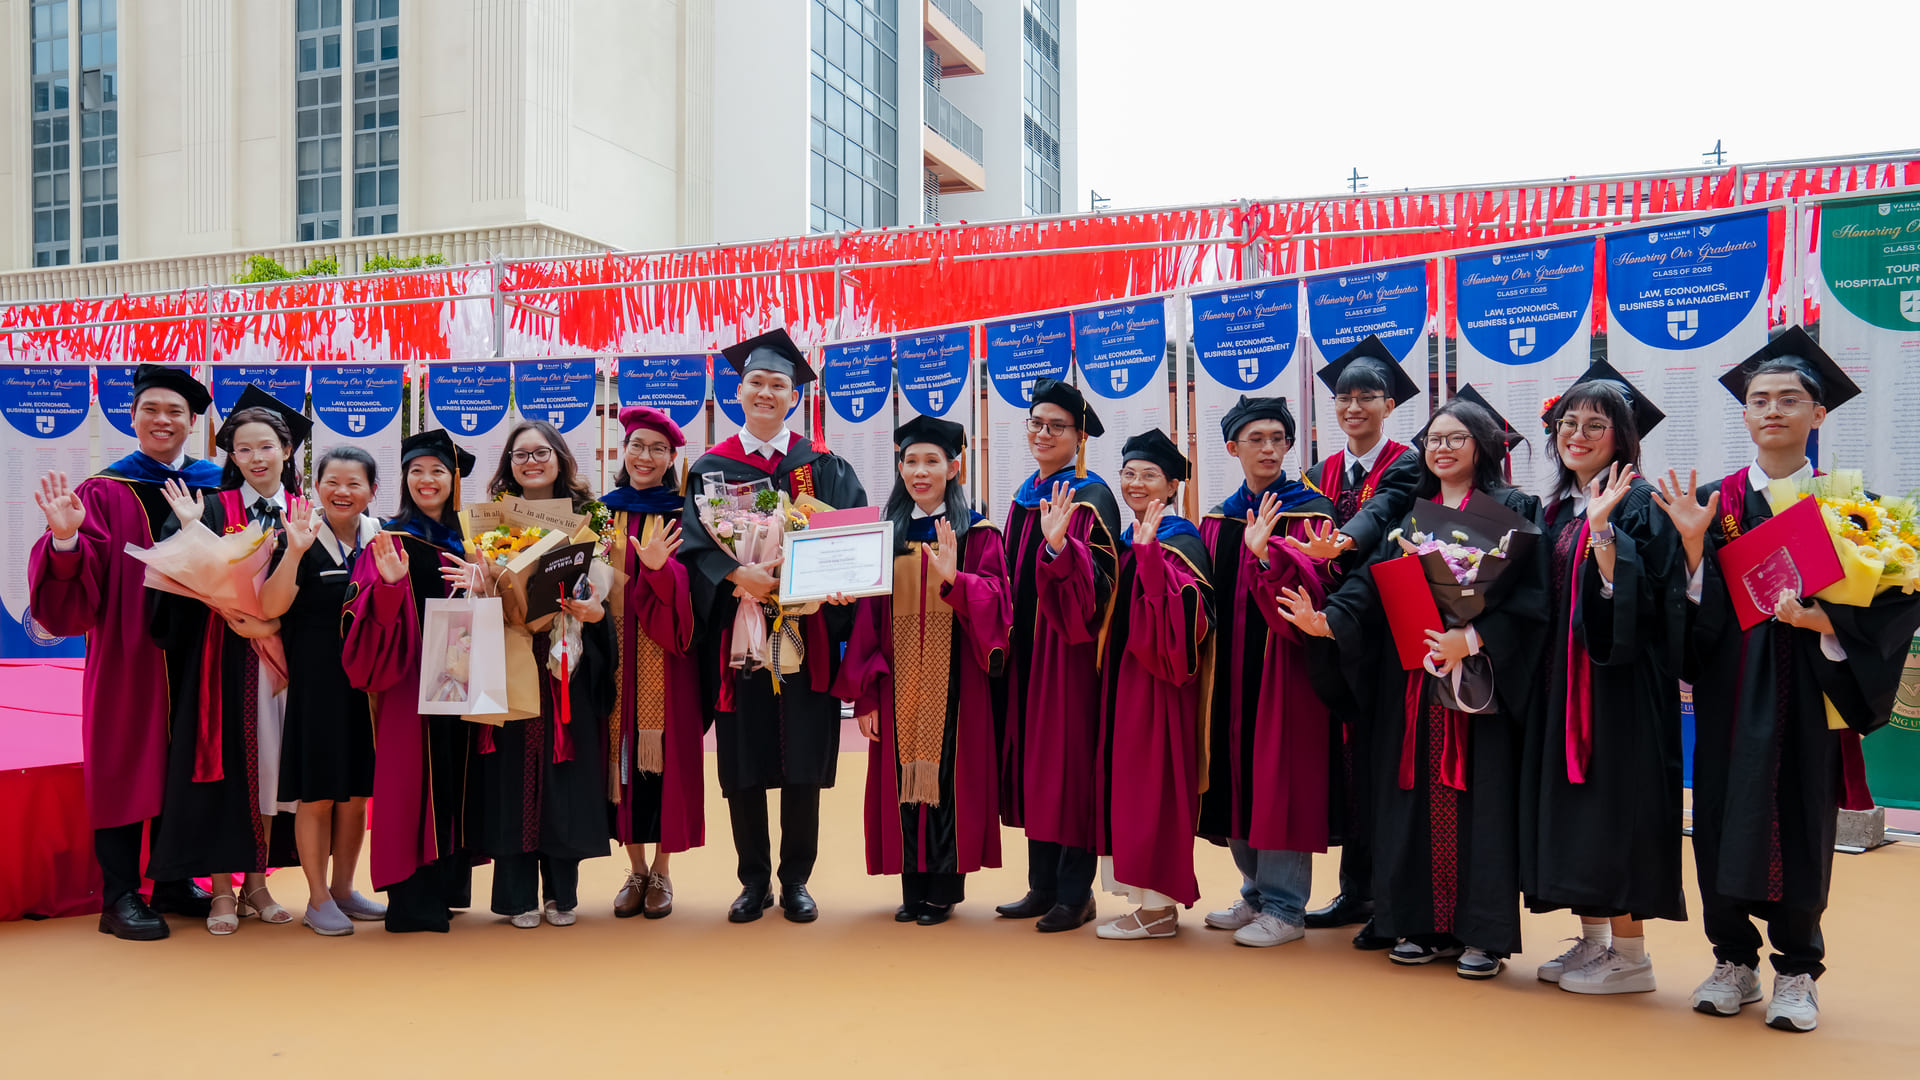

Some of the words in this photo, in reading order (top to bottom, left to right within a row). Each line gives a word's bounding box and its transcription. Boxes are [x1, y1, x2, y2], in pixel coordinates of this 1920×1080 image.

[1832, 224, 1902, 240] Honoring
[1613, 252, 1667, 265] Honoring
[1670, 246, 1692, 260] Our
[1697, 240, 1756, 262] Graduates
[1884, 245, 1915, 253] CLASS
[1463, 273, 1508, 286] Honoring
[1512, 268, 1531, 280] Our
[1535, 264, 1584, 283] Graduates
[1886, 264, 1920, 274] TOUR
[1835, 276, 1914, 288] HOSPITALITY
[1315, 293, 1354, 306] Honoring
[1357, 290, 1372, 300] Our
[1376, 285, 1418, 304] Graduates
[1640, 290, 1662, 298] LAW,
[1664, 283, 1728, 296] ECONOMICS,
[1620, 300, 1664, 312] BUSINESS
[1676, 290, 1750, 306] MANAGEMENT
[1199, 309, 1235, 321] Honoring
[1238, 307, 1252, 318] Our
[1254, 303, 1292, 320] Graduates
[1485, 308, 1504, 316] LAW,
[1507, 302, 1559, 314] ECONOMICS,
[1354, 320, 1397, 332] ECONOMICS,
[1468, 318, 1507, 328] BUSINESS
[1517, 310, 1578, 324] MANAGEMENT
[1080, 325, 1109, 336] Honoring
[1111, 322, 1124, 331] Our
[1127, 318, 1159, 332] Graduates
[992, 337, 1020, 347] Honoring
[1022, 335, 1034, 344] Our
[1037, 332, 1066, 345] Graduates
[1235, 336, 1275, 347] ECONOMICS,
[1322, 336, 1355, 346] BUSINESS
[1364, 328, 1414, 340] MNAGEMENT
[1108, 349, 1144, 358] ECONOMICS,
[1204, 349, 1236, 358] BUSINESS
[1244, 342, 1290, 354] MANAGEMENT
[1020, 361, 1051, 370] ECONOMICS,
[1116, 355, 1156, 366] MANAGEMENT
[926, 372, 951, 382] ECONOMICS,
[1026, 366, 1063, 377] MANAGEMENT
[933, 378, 961, 387] MANAGEMENT
[794, 467, 806, 494] NLAN
[803, 465, 815, 498] IVERSITY
[536, 512, 544, 520] all
[546, 516, 564, 526] one's
[565, 520, 577, 528] life
[1897, 706, 1914, 715] Since
[1890, 715, 1908, 726] NG
